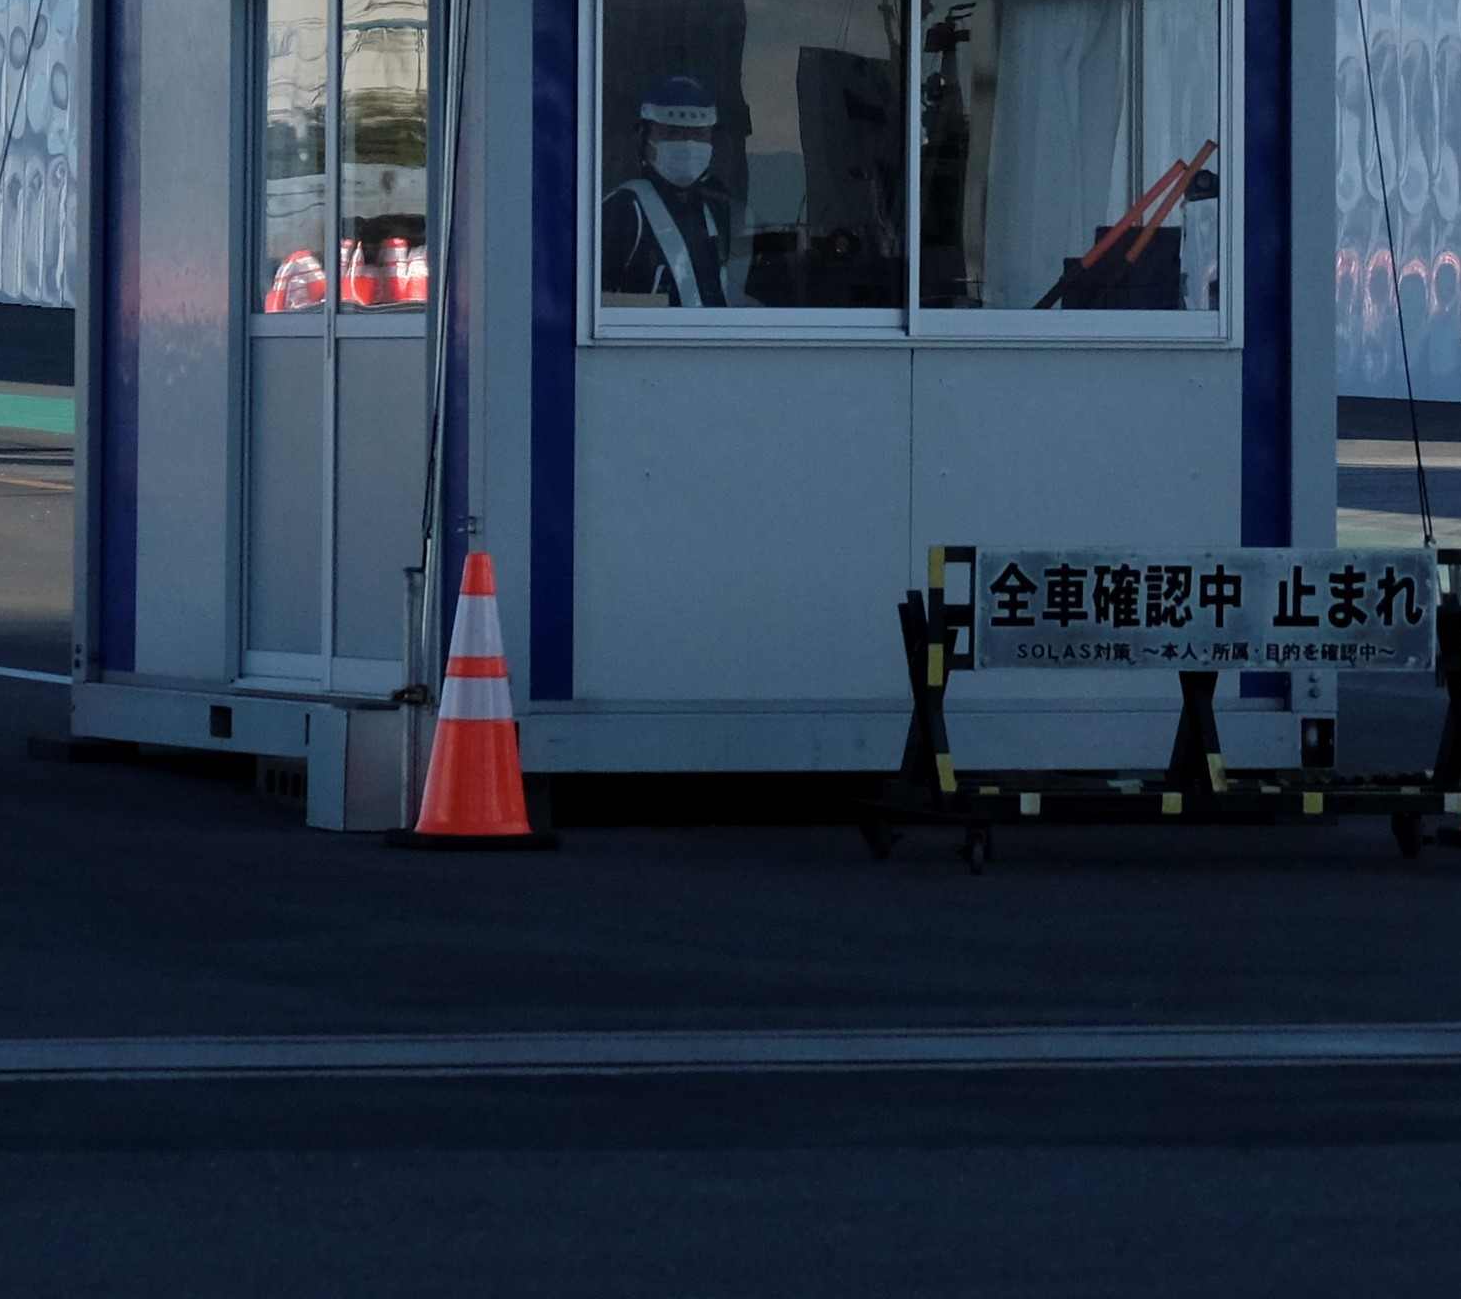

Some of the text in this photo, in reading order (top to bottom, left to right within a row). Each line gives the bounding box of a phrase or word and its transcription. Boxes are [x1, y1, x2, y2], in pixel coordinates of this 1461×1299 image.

[989, 562, 1423, 628] 全車確認中 止まれ
[1017, 643, 1132, 661] SOLAS対策
